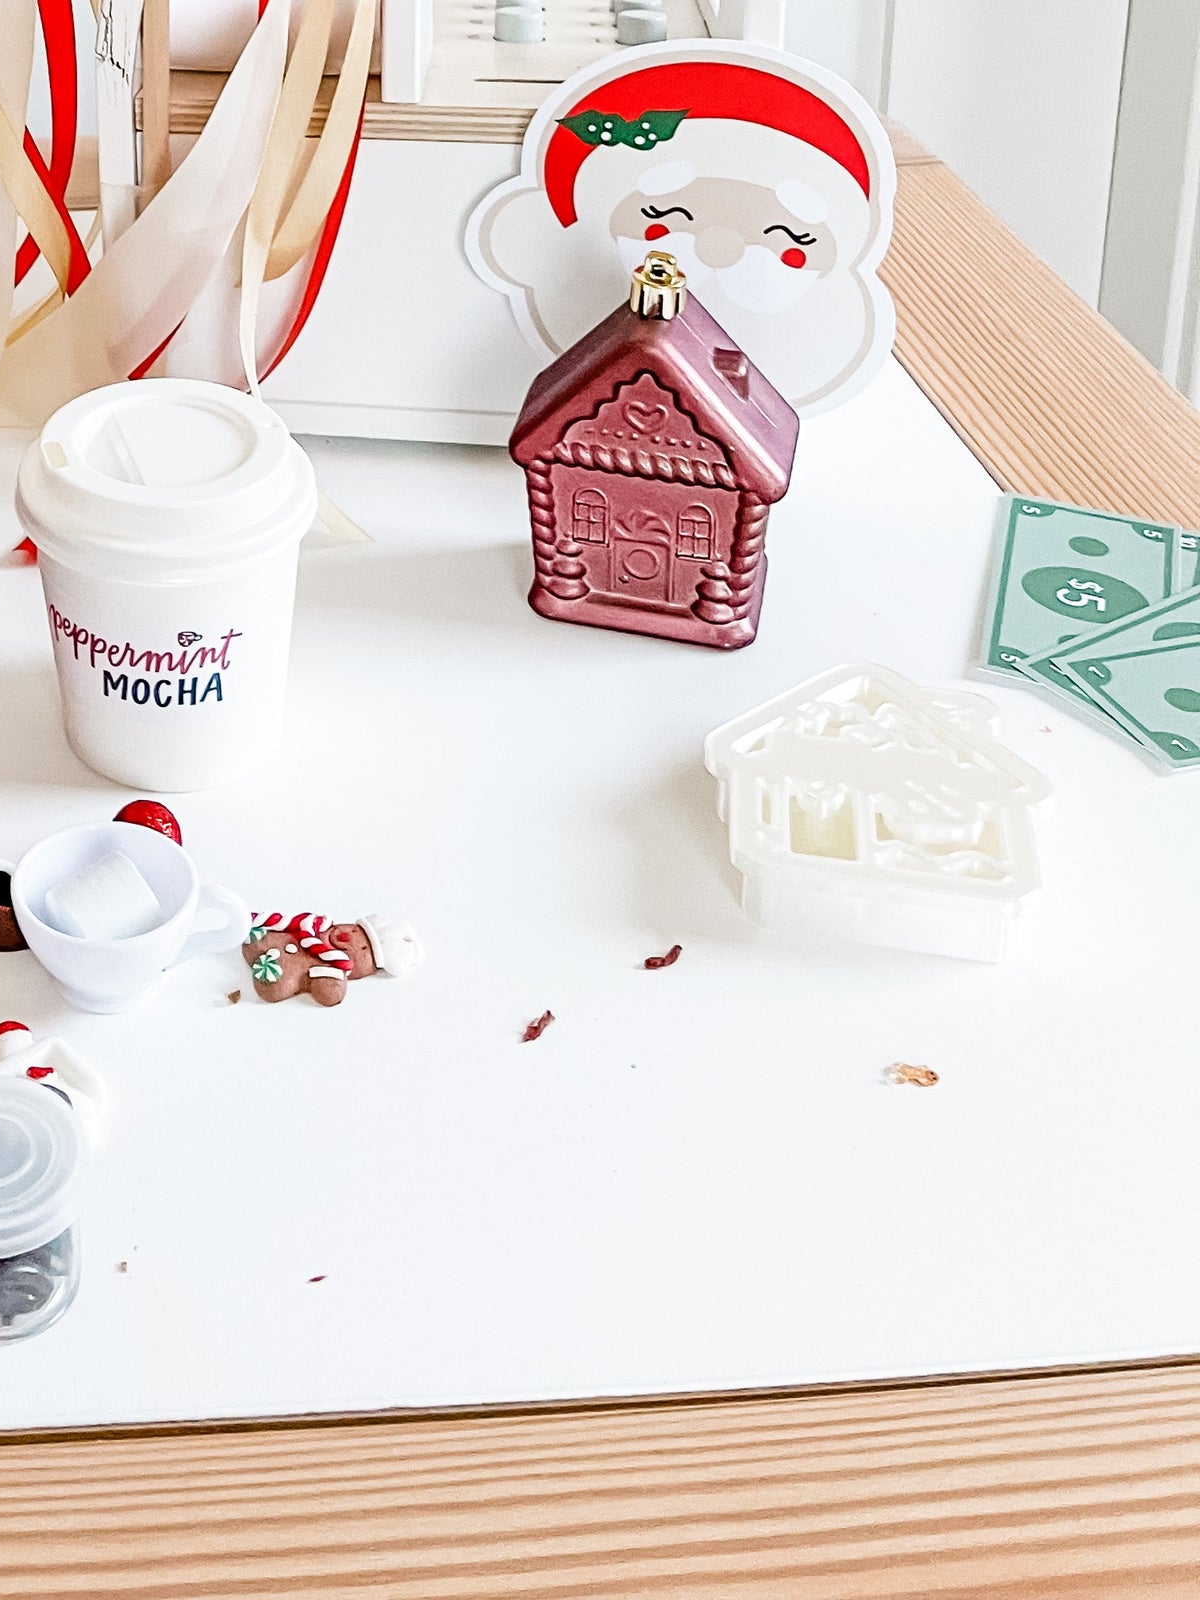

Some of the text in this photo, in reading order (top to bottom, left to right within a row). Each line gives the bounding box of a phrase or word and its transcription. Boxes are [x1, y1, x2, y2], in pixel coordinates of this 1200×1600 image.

[1056, 577, 1107, 612] $5
[47, 603, 243, 674] peppermint
[103, 669, 224, 708] MOCHA
